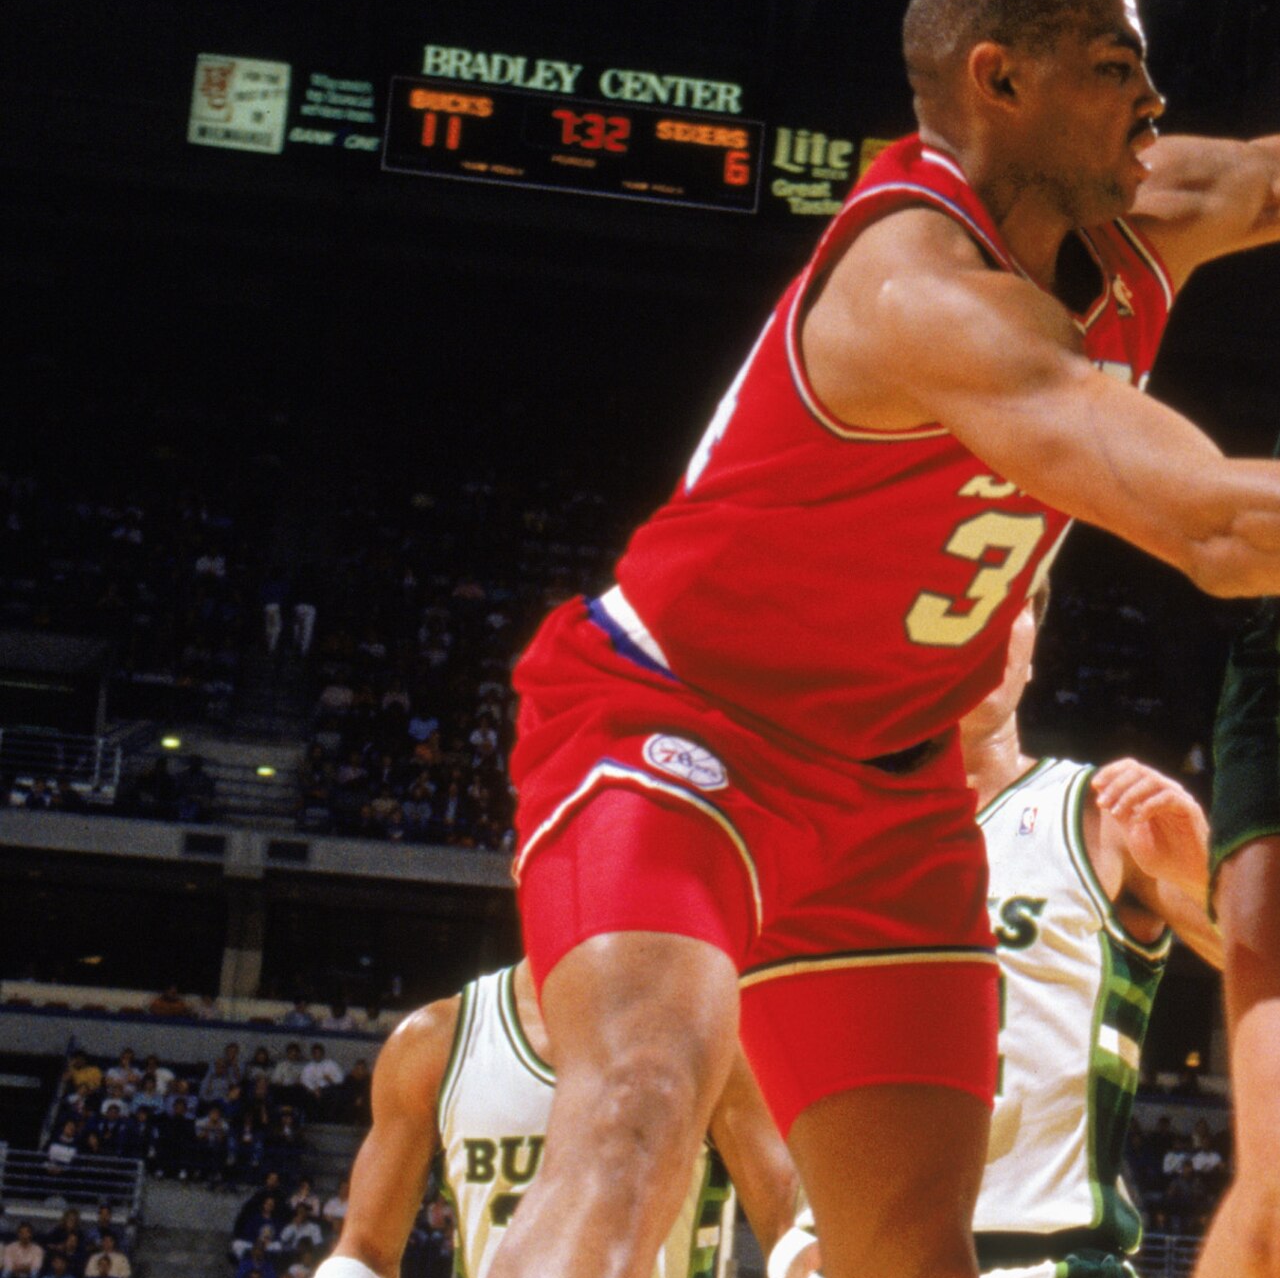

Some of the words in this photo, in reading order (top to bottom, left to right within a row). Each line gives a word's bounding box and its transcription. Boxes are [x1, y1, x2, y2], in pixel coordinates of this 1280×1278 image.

[422, 44, 583, 94] BRADLEY
[599, 68, 743, 115] CENTER
[421, 111, 462, 151] 11
[551, 108, 632, 153] 7:32
[772, 126, 853, 174] Lite
[722, 149, 751, 186] 6
[463, 1134, 546, 1185] BU
